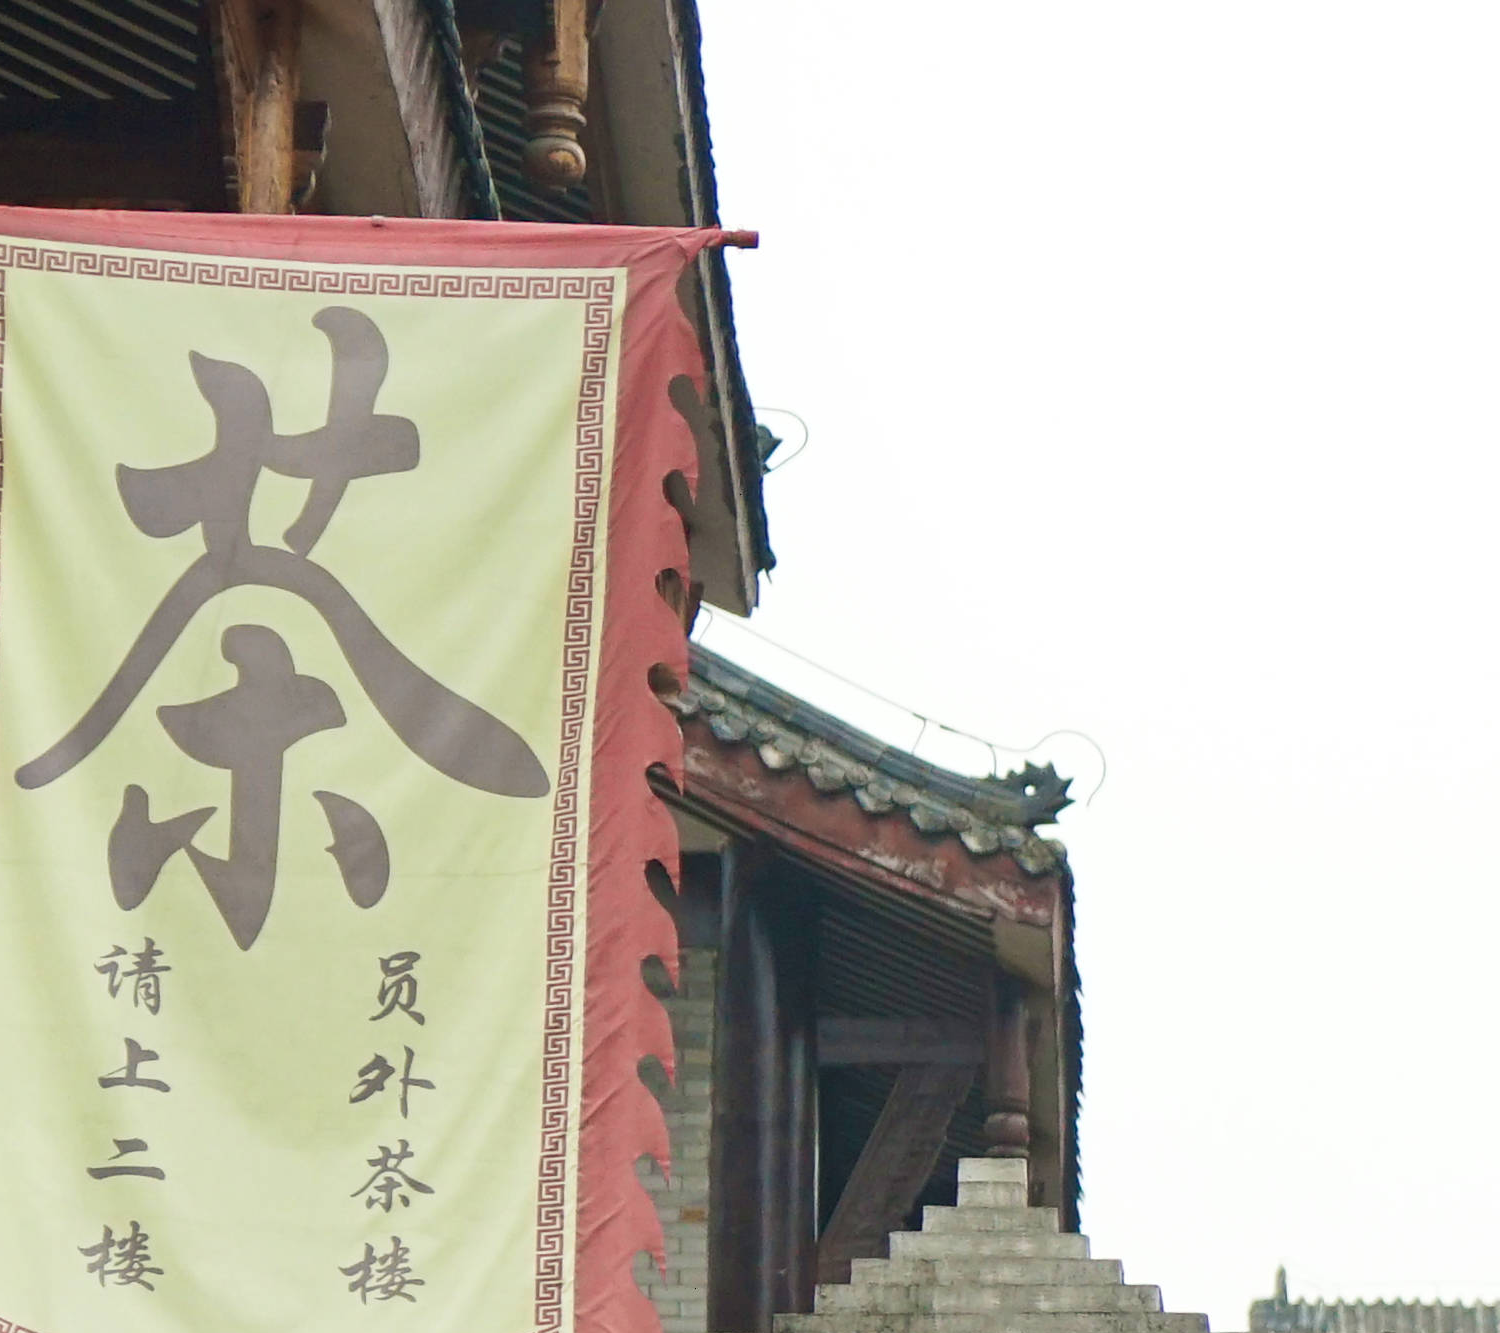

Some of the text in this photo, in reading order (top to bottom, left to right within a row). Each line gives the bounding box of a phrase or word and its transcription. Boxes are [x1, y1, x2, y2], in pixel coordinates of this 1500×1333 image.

[13, 304, 552, 952] 茶
[77, 942, 173, 1293] 请上二楼
[339, 950, 437, 1305] 员外茶楼
